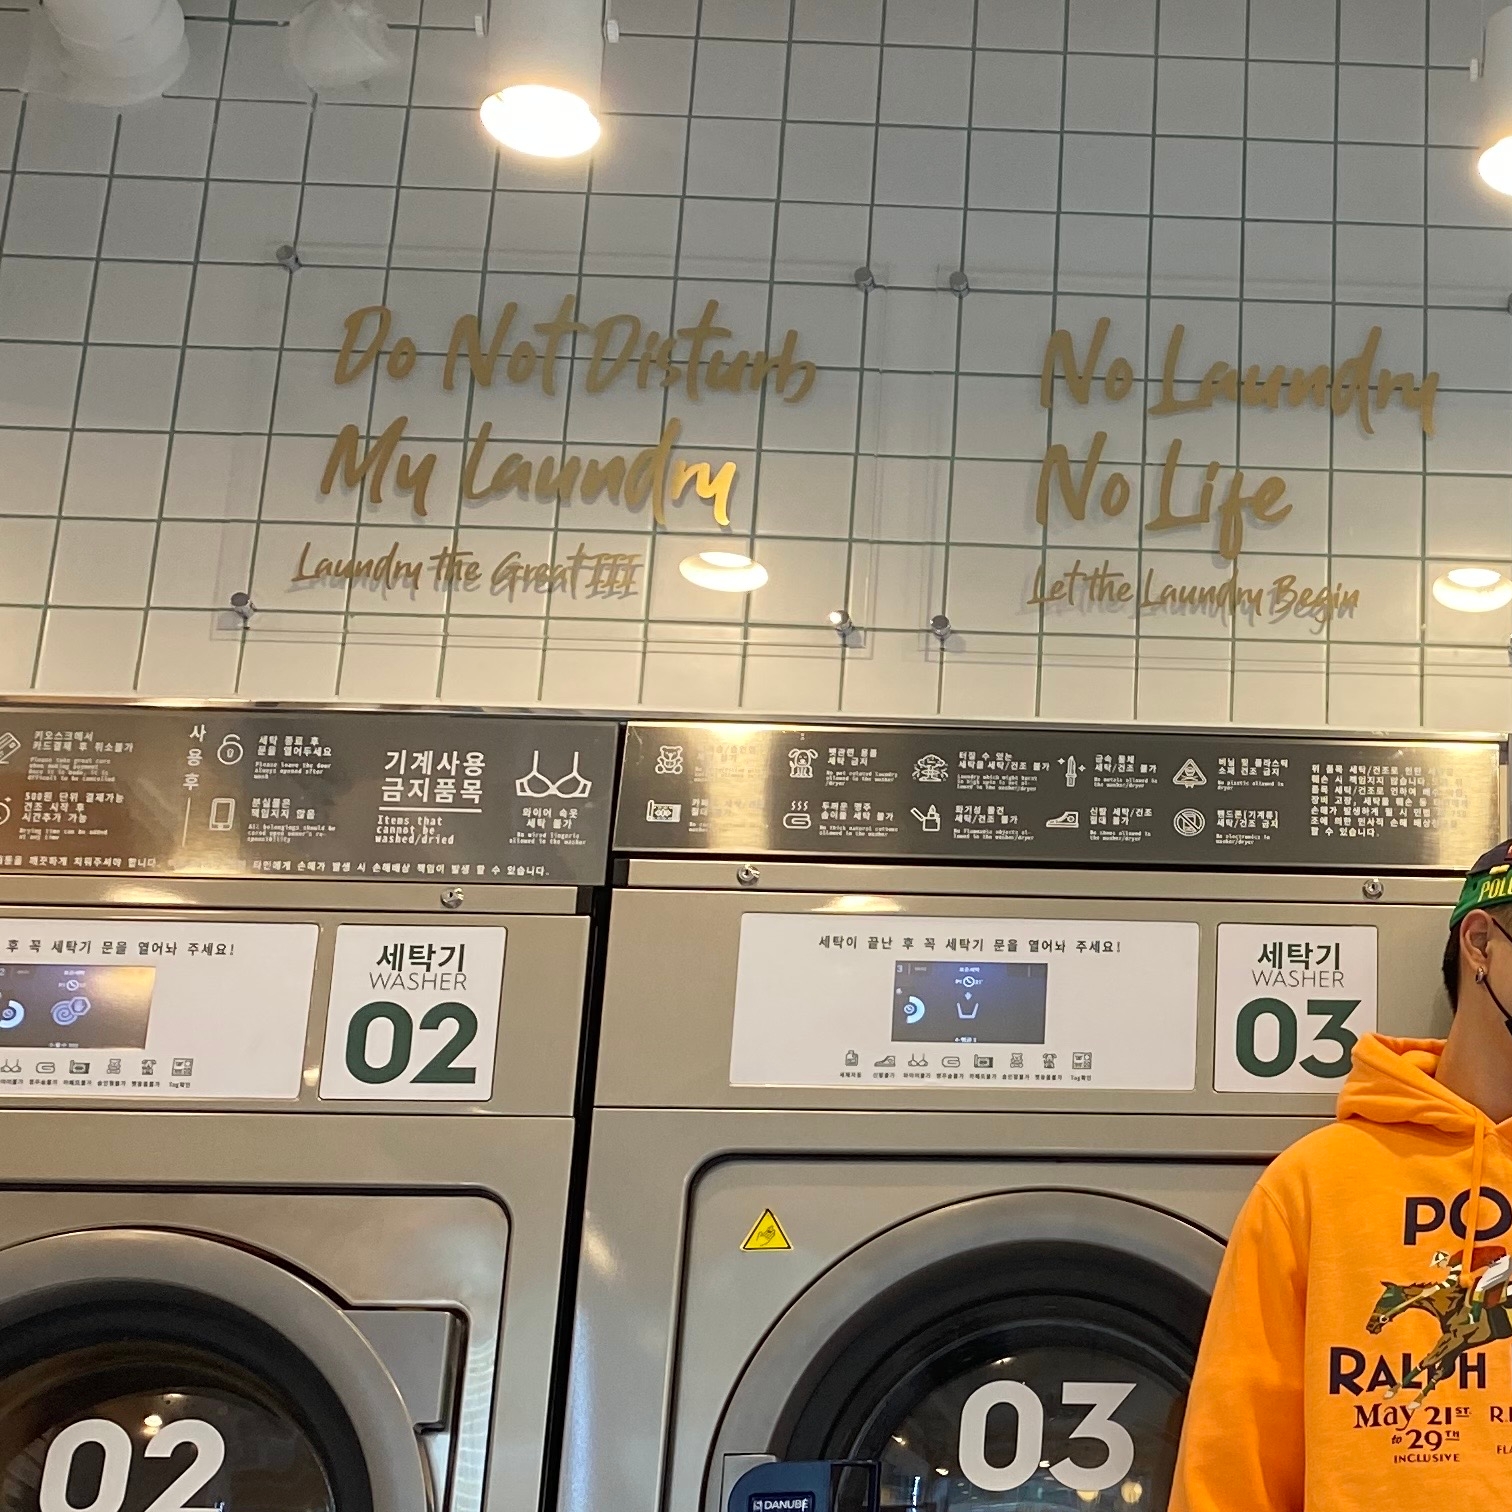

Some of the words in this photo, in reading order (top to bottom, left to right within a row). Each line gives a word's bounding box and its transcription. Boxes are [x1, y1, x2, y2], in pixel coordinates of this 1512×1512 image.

[335, 305, 416, 385] Do
[443, 295, 589, 397] Not
[585, 300, 817, 403] Disturb
[1040, 317, 1132, 409] No
[1148, 324, 1439, 437] Laundry
[321, 416, 436, 517] My
[462, 418, 737, 526] Laundry
[1037, 431, 1130, 525] No
[1145, 439, 1293, 561] Life
[292, 542, 421, 590] Laundry
[430, 541, 482, 584] the
[491, 542, 585, 592] Great
[1028, 560, 1080, 605] Let
[1085, 560, 1133, 601] the
[1141, 569, 1262, 615] Laundry
[1275, 575, 1359, 623] Begin
[35, 731, 93, 741] 키오스크에서
[259, 735, 277, 746] 세탁
[311, 736, 319, 746] 후
[33, 741, 72, 751] 카드결제
[79, 742, 87, 751] 후
[258, 746, 276, 756] 문을
[284, 746, 332, 756] 열어두세요
[385, 750, 485, 776] 기계사용
[1095, 755, 1112, 764] 금속
[382, 778, 483, 804] 금지품목
[25, 792, 52, 802] 500원
[59, 792, 78, 802] 단위
[86, 793, 124, 803] 결제가능
[252, 798, 290, 808] 분실물은
[24, 802, 42, 812] 건조
[50, 802, 68, 812] 시작
[76, 803, 85, 812] 후
[251, 808, 290, 818] 책임지지
[523, 808, 552, 818] 와이어
[559, 808, 579, 818] 속옷
[1090, 807, 1107, 817] 신발
[1113, 808, 1152, 818] 세탁/건조
[22, 812, 61, 822] 시간추가
[68, 813, 87, 823] 가능
[378, 815, 410, 826] Items
[417, 816, 443, 826] that
[527, 818, 545, 828] 세탁
[553, 819, 572, 829] 불가
[377, 826, 415, 836] cannot
[423, 827, 435, 836] be
[375, 834, 454, 846] washed/dried
[491, 865, 501, 875] 수
[6, 940, 19, 952] 후
[29, 940, 41, 952] 꼭
[51, 940, 91, 953] 세탁기
[101, 941, 127, 954] 문을
[138, 941, 177, 955] 열어놔
[187, 942, 234, 956] 주세요!
[819, 935, 858, 950] 세탁이
[868, 936, 893, 951] 끝난
[903, 937, 915, 951] 후
[925, 937, 936, 951] 꼭
[946, 937, 984, 952] 세탁기
[994, 938, 1018, 953] 문을
[1029, 939, 1067, 953] 열어놔
[1076, 940, 1121, 954] 주세요!
[376, 943, 465, 972] 세탁기
[1258, 942, 1340, 970] 세탁기
[369, 972, 467, 990] WASHER
[1252, 969, 1344, 987] WASHER
[346, 1001, 478, 1084] 02
[1236, 998, 1362, 1078] 03
[1353, 1403, 1415, 1431] May
[959, 1380, 1137, 1492] 03
[1392, 1434, 1402, 1444] to
[1394, 1453, 1460, 1463] INCLUSIVE
